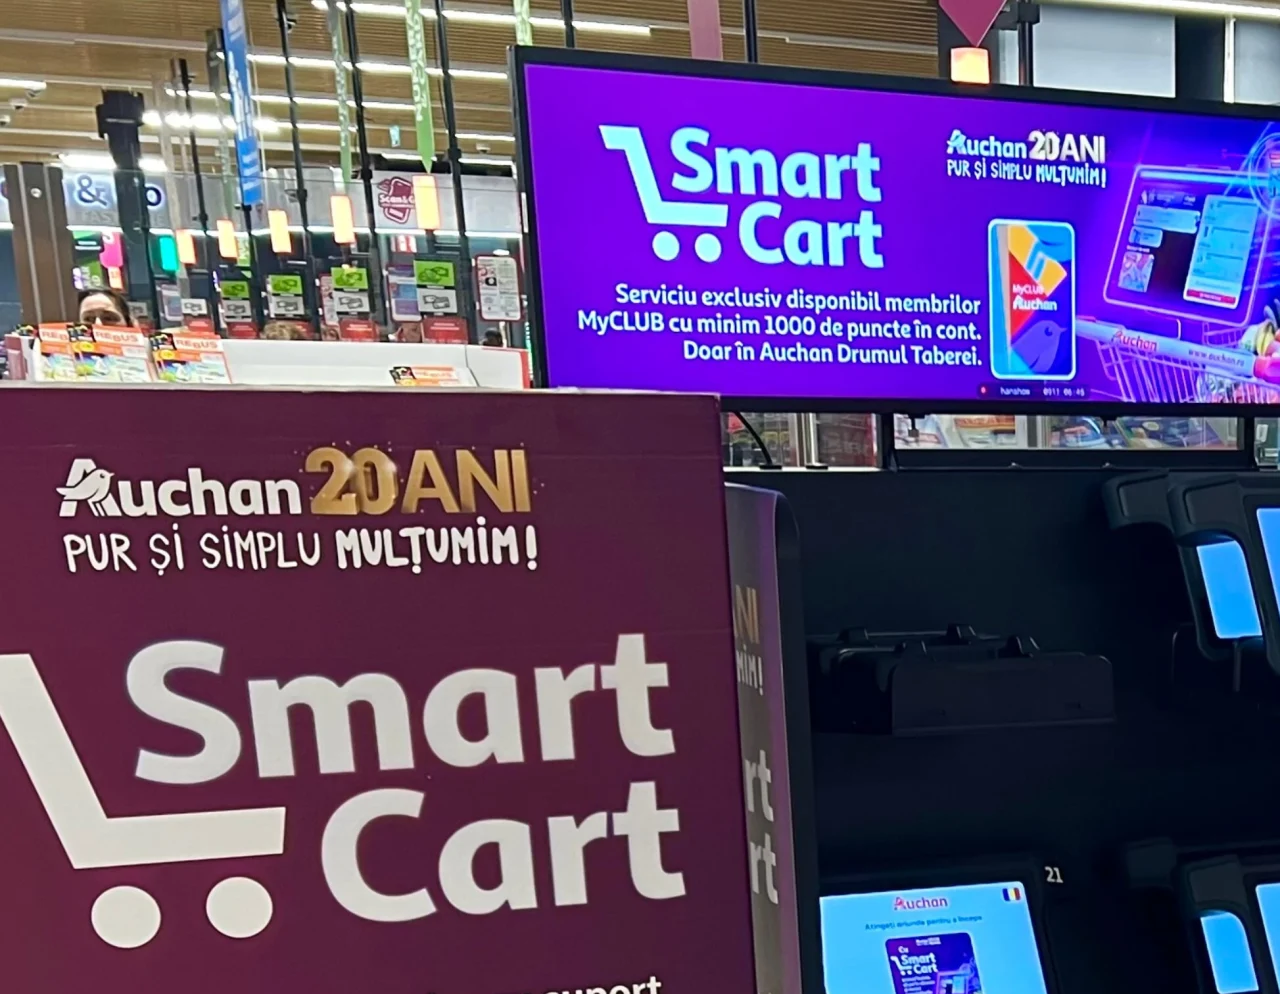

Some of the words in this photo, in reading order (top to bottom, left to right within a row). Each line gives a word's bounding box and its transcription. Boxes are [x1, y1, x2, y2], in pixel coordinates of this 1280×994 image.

[947, 129, 1027, 159] Auchan
[670, 126, 883, 202] Smart
[947, 159, 971, 178] PUR
[738, 202, 886, 269] Cart
[616, 283, 697, 305] Serviciu
[701, 288, 781, 308] exclusiv
[786, 289, 881, 315] disponibil
[885, 294, 982, 315] membrilor
[1012, 295, 1057, 311] Auchan
[578, 310, 665, 335] MyCLUB
[669, 317, 693, 333] cu
[697, 315, 760, 335] minim
[764, 315, 815, 336] 1000
[820, 317, 843, 337] de
[848, 319, 911, 341] puncte
[913, 317, 933, 338] în
[936, 321, 982, 340] cont.
[684, 340, 732, 361] Doar
[735, 341, 755, 361] în
[760, 342, 833, 363] Auchan
[837, 344, 907, 365] Drumul
[911, 345, 982, 366] Taberei.
[1112, 331, 1157, 352] Auchan
[56, 458, 301, 517] Auchan
[63, 532, 138, 573] PUR
[200, 524, 321, 570] SIMPLU
[126, 633, 676, 785] Smart
[321, 781, 687, 923] Cart
[1044, 866, 1064, 884] 21
[893, 896, 948, 911] Auchan
[901, 953, 936, 965] Smart
[913, 963, 938, 974] Cart
